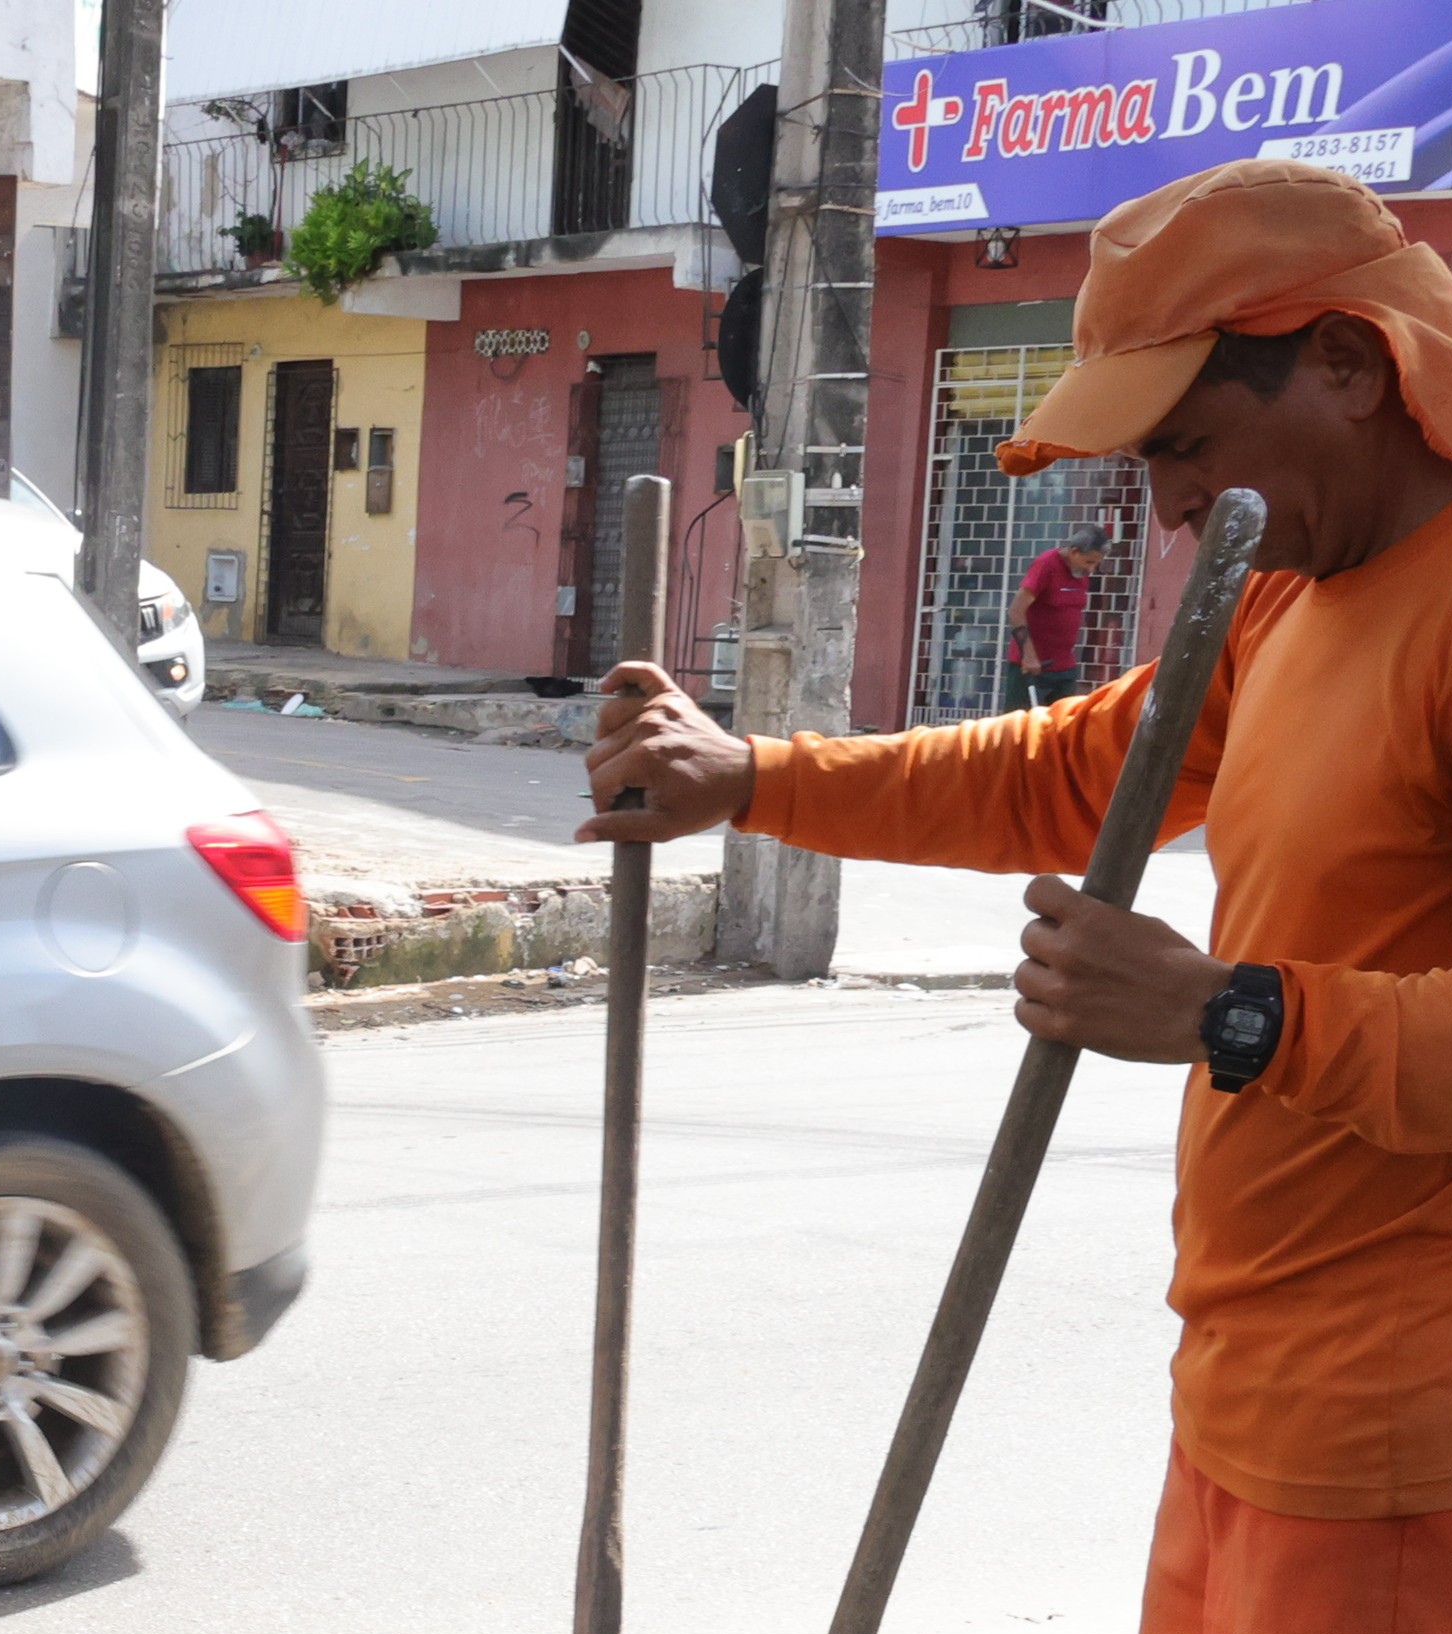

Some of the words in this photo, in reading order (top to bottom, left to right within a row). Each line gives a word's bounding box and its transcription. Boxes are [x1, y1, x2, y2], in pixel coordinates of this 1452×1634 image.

[960, 77, 1158, 162] Farma
[1159, 48, 1344, 140] Bem
[1291, 132, 1402, 159] 3283-8157
